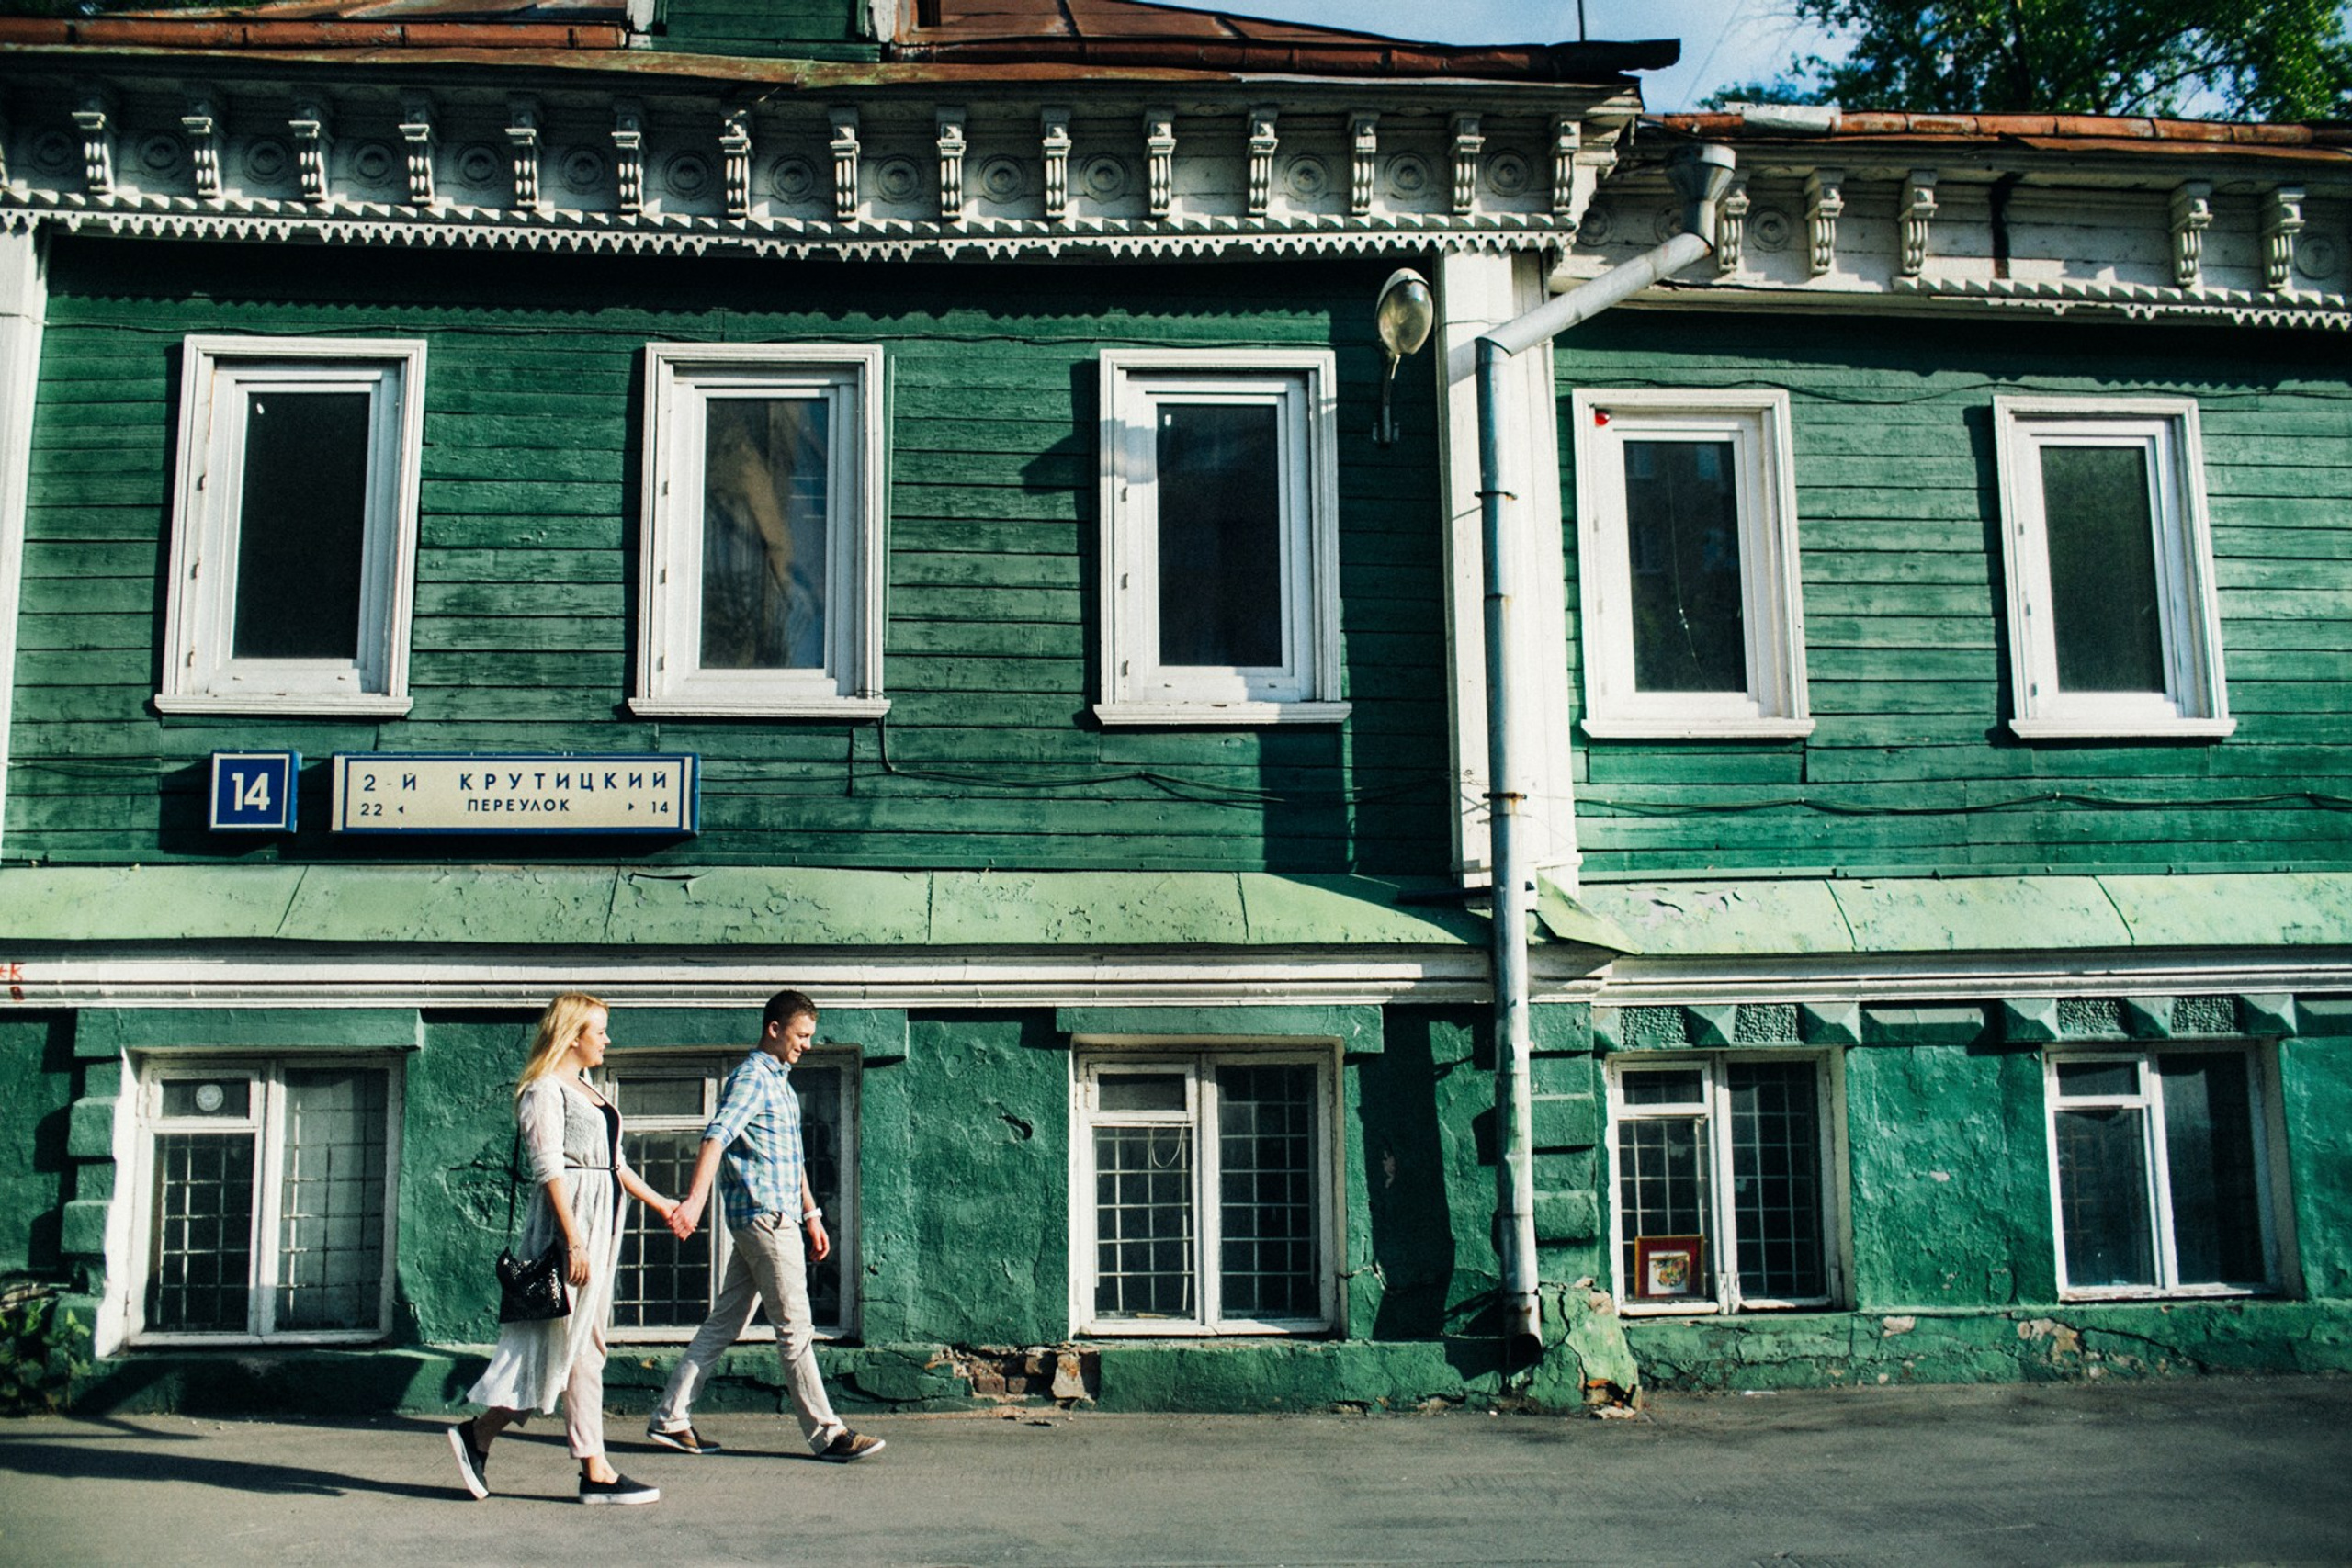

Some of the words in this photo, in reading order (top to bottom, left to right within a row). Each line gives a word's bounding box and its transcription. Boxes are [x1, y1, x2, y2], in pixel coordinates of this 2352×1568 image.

[232, 772, 271, 812] 14
[459, 771, 667, 792] КРУТИЦКИЙ
[360, 802, 383, 816] 22
[467, 798, 570, 812] ПЕРЕУЛОК
[651, 801, 669, 814] 14
